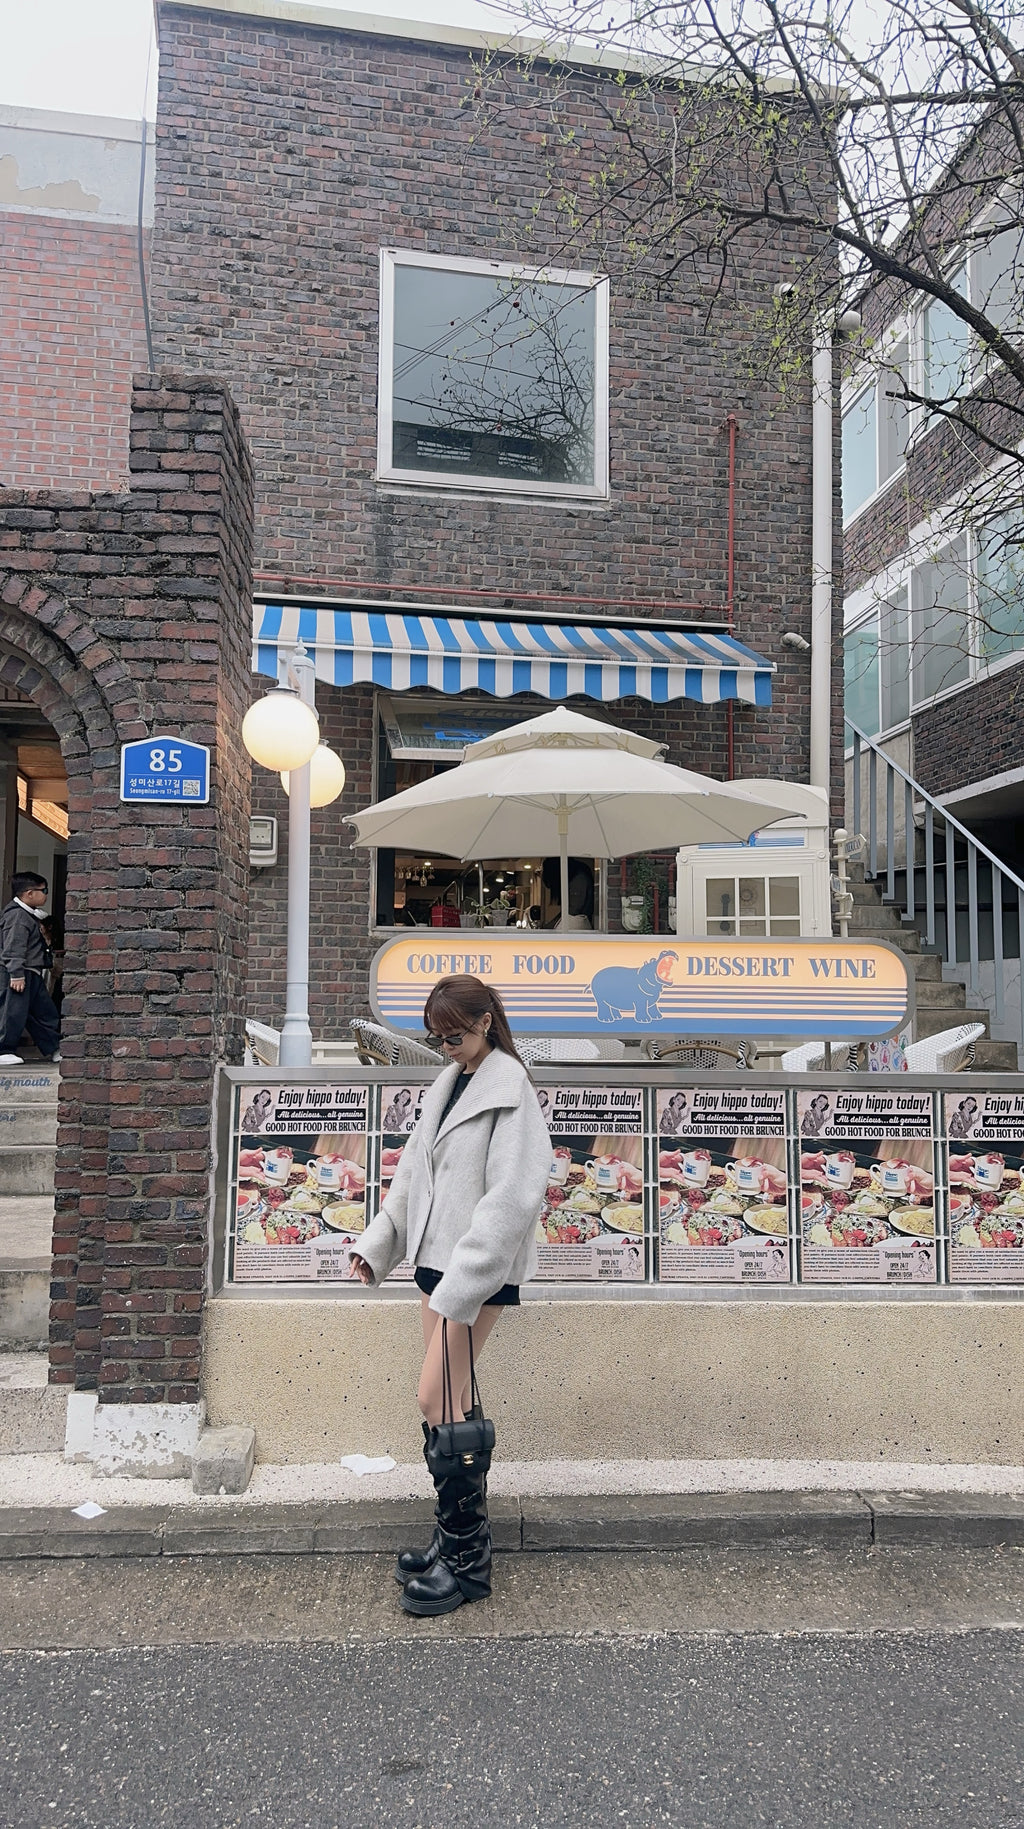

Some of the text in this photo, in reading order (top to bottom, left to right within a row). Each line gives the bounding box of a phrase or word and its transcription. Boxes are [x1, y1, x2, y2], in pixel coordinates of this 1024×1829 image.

[149, 748, 183, 773] 85
[129, 778, 180, 788] 성미산로17길
[406, 953, 576, 975] COFFEE FOOD
[686, 956, 876, 979] DESSERT WINE
[0, 1077, 52, 1091] ig mouth
[278, 1089, 367, 1107] Enjoy hippo today!
[555, 1090, 641, 1108] Enjoy hippo today!
[693, 1092, 783, 1111] Enjoy hippo today!
[836, 1094, 930, 1113] Enjoy hippo today!
[985, 1096, 1012, 1114] Enjoy
[277, 1111, 290, 1119] All
[337, 1111, 364, 1120] genuine
[613, 1113, 639, 1121] genuine
[754, 1116, 781, 1124] genuine
[985, 1117, 998, 1125] All
[265, 1121, 366, 1132] GOOD HOT FOOD FOR BRUNCH
[900, 1117, 928, 1126] genuine
[565, 1123, 579, 1132] HOT
[580, 1123, 598, 1133] FOOD
[600, 1123, 614, 1133] FOR
[615, 1124, 641, 1133] BRUNCH
[682, 1125, 784, 1136] GOOD HOT FOOD FOR BRUNCH
[825, 1127, 931, 1137] GOOD HOT FOOD FOR BRUNCH
[973, 1128, 1024, 1139] GOOD HOT FO
